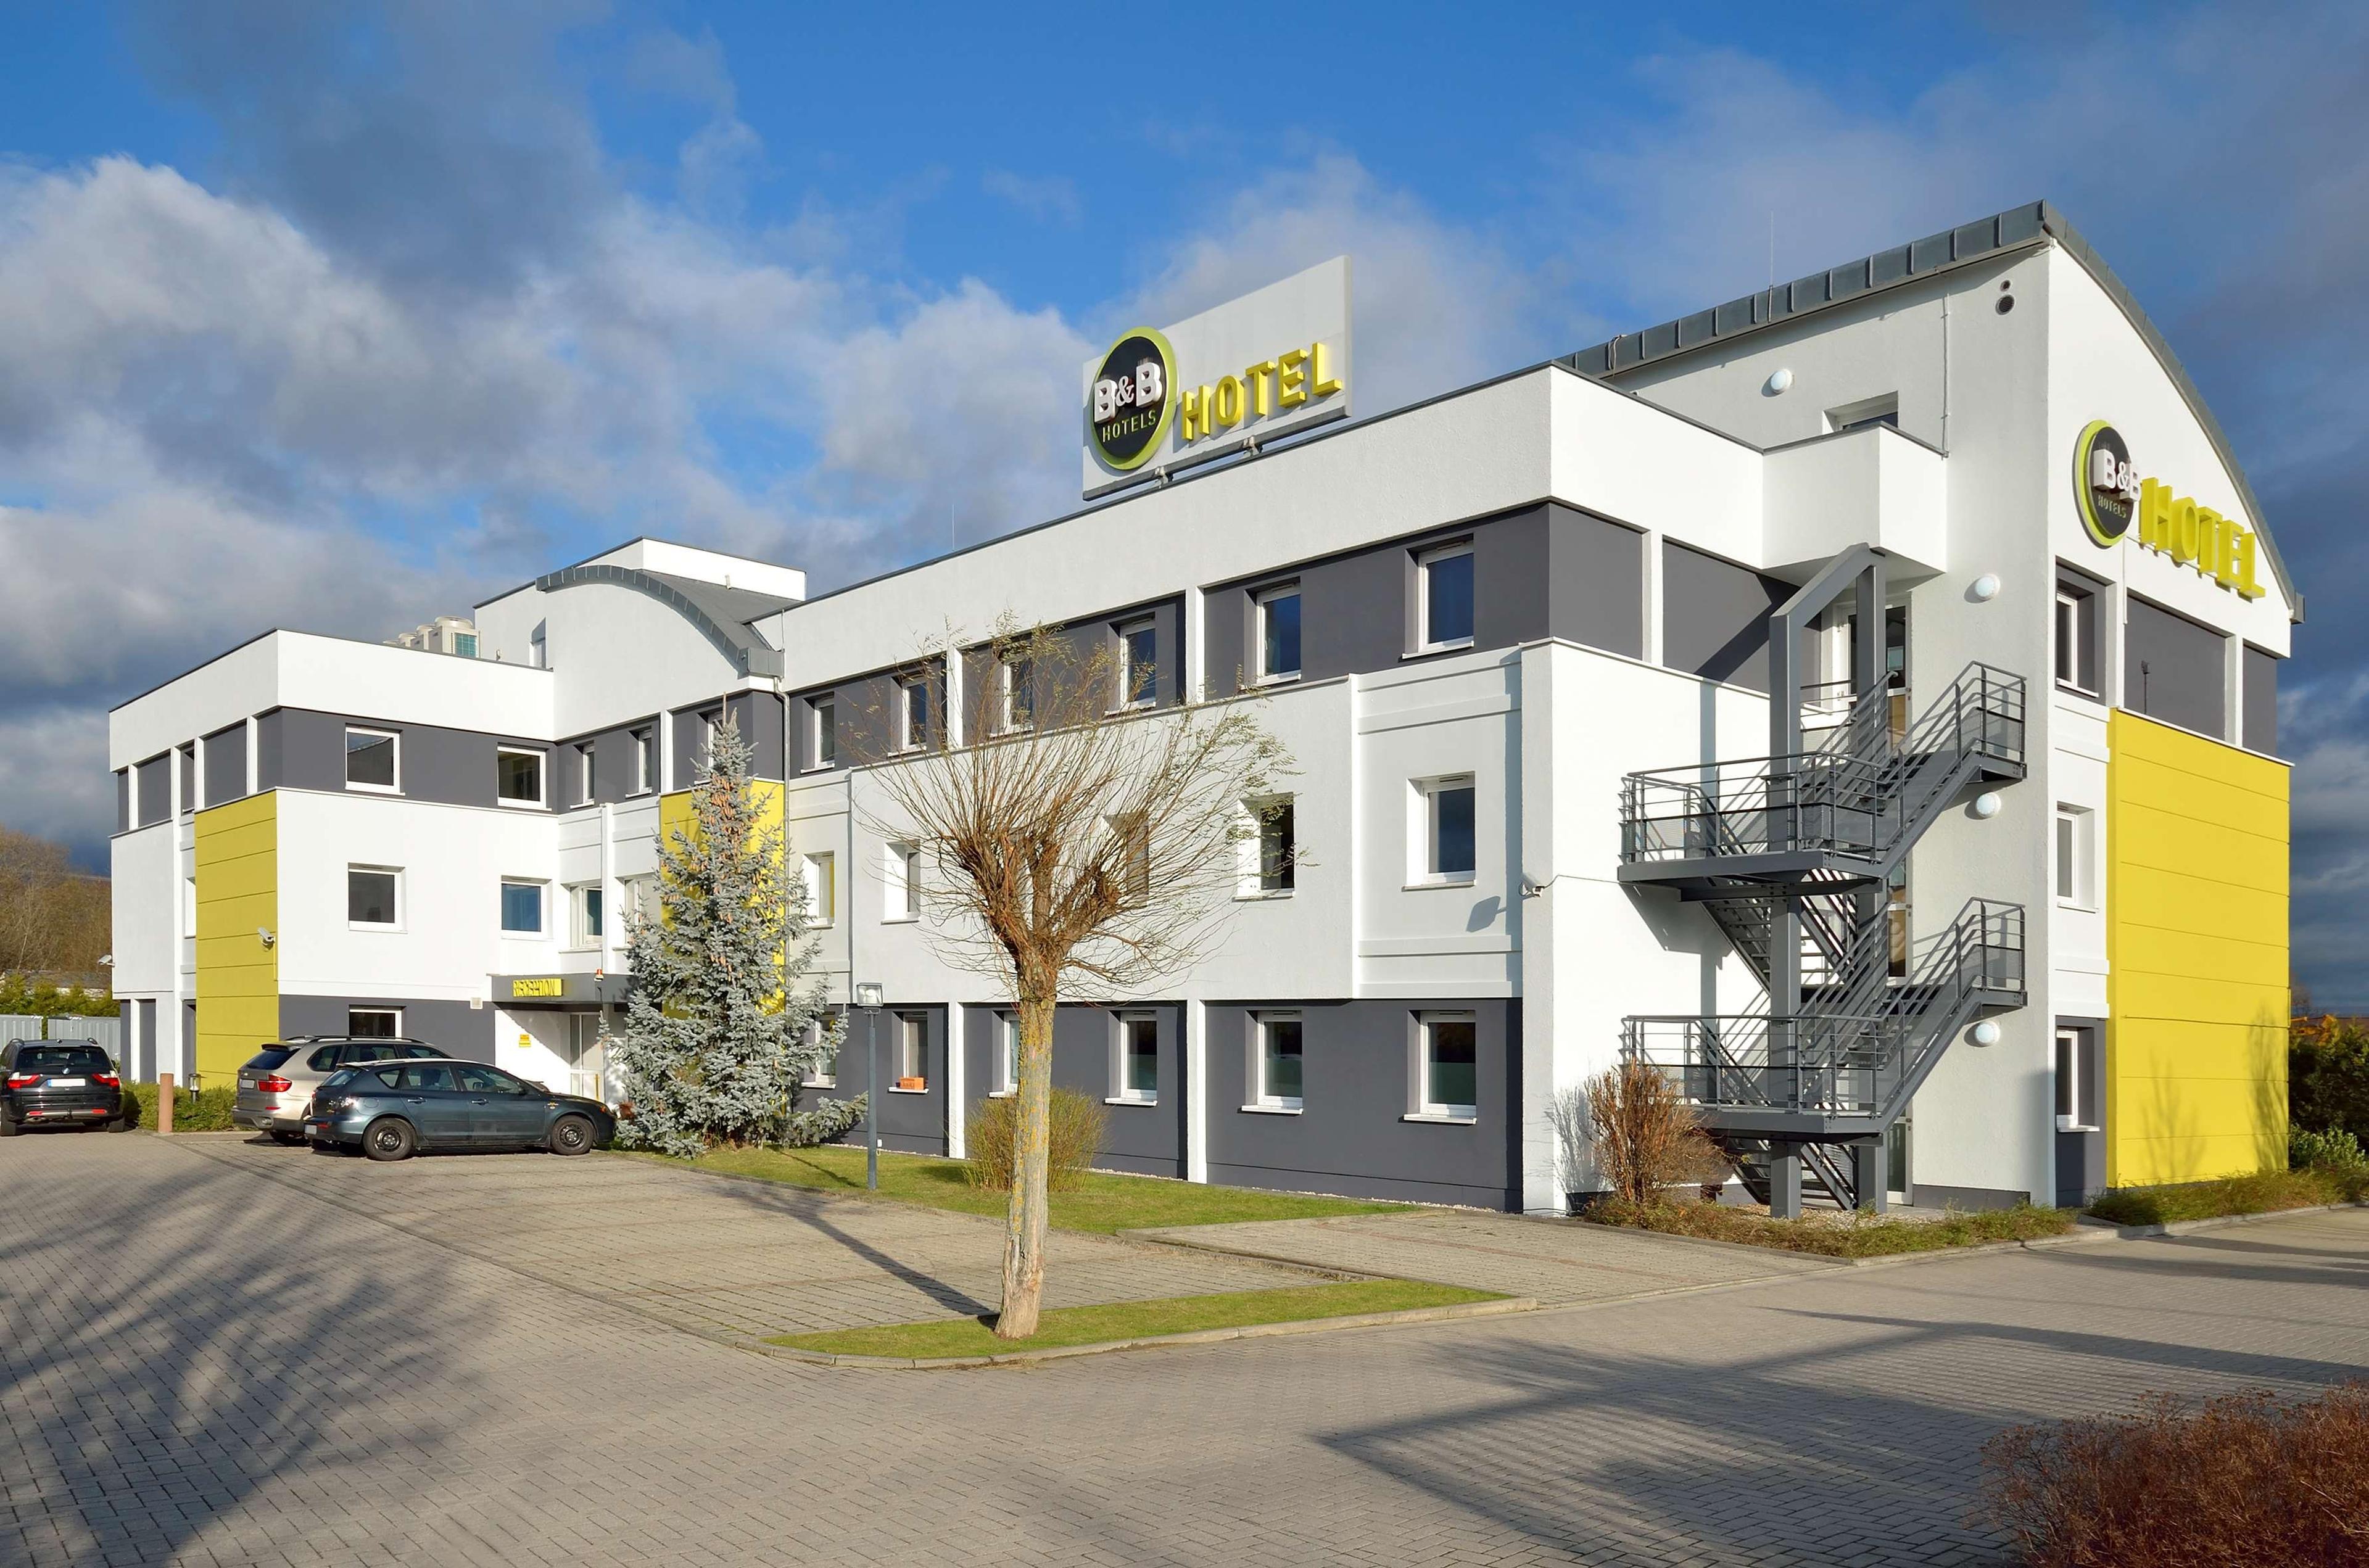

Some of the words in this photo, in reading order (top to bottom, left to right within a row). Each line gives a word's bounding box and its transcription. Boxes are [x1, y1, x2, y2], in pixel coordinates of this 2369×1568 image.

[1094, 362, 1163, 423] B&B
[1181, 342, 1343, 441] HOTEL
[1102, 409, 1157, 443] HOTELS
[2093, 448, 2142, 503] B&B
[2098, 494, 2127, 519] HOTELS
[2140, 477, 2266, 600] HOTEL
